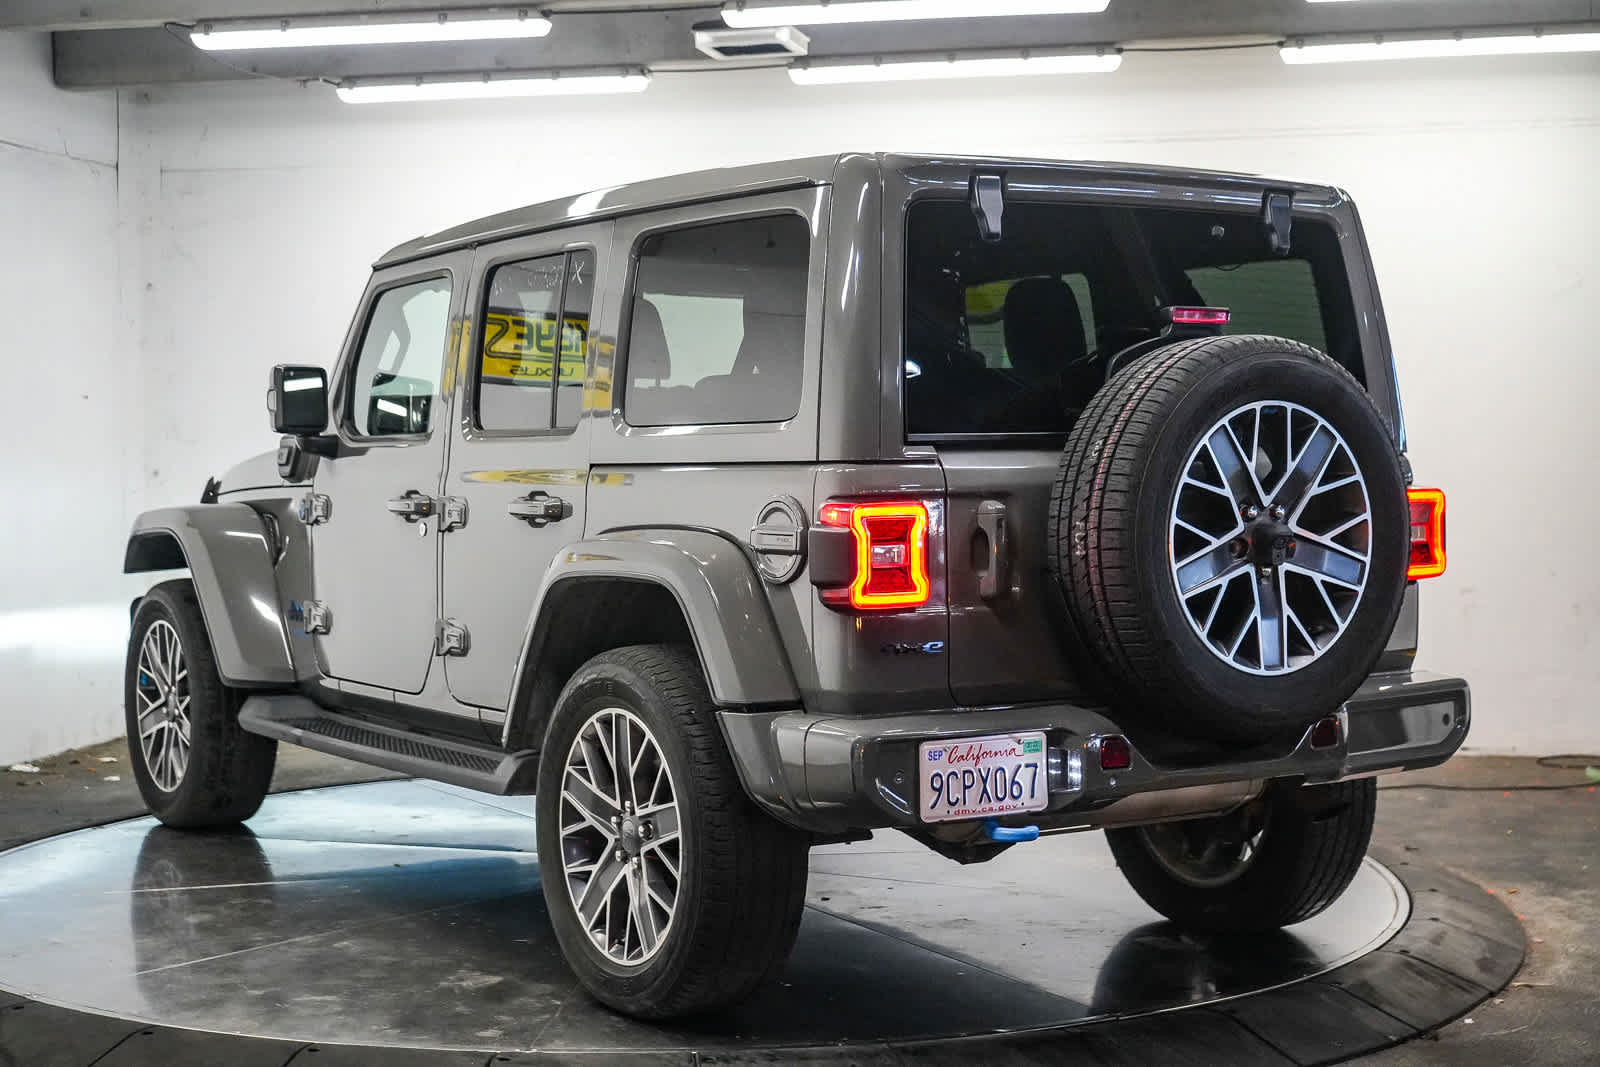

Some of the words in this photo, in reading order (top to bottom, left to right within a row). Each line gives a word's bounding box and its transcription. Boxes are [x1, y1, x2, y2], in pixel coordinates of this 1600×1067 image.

[928, 750, 943, 761] SEP
[948, 744, 1025, 766] California
[930, 763, 1038, 810] 9CPX067
[954, 804, 1018, 816] dmv.ca.gov
